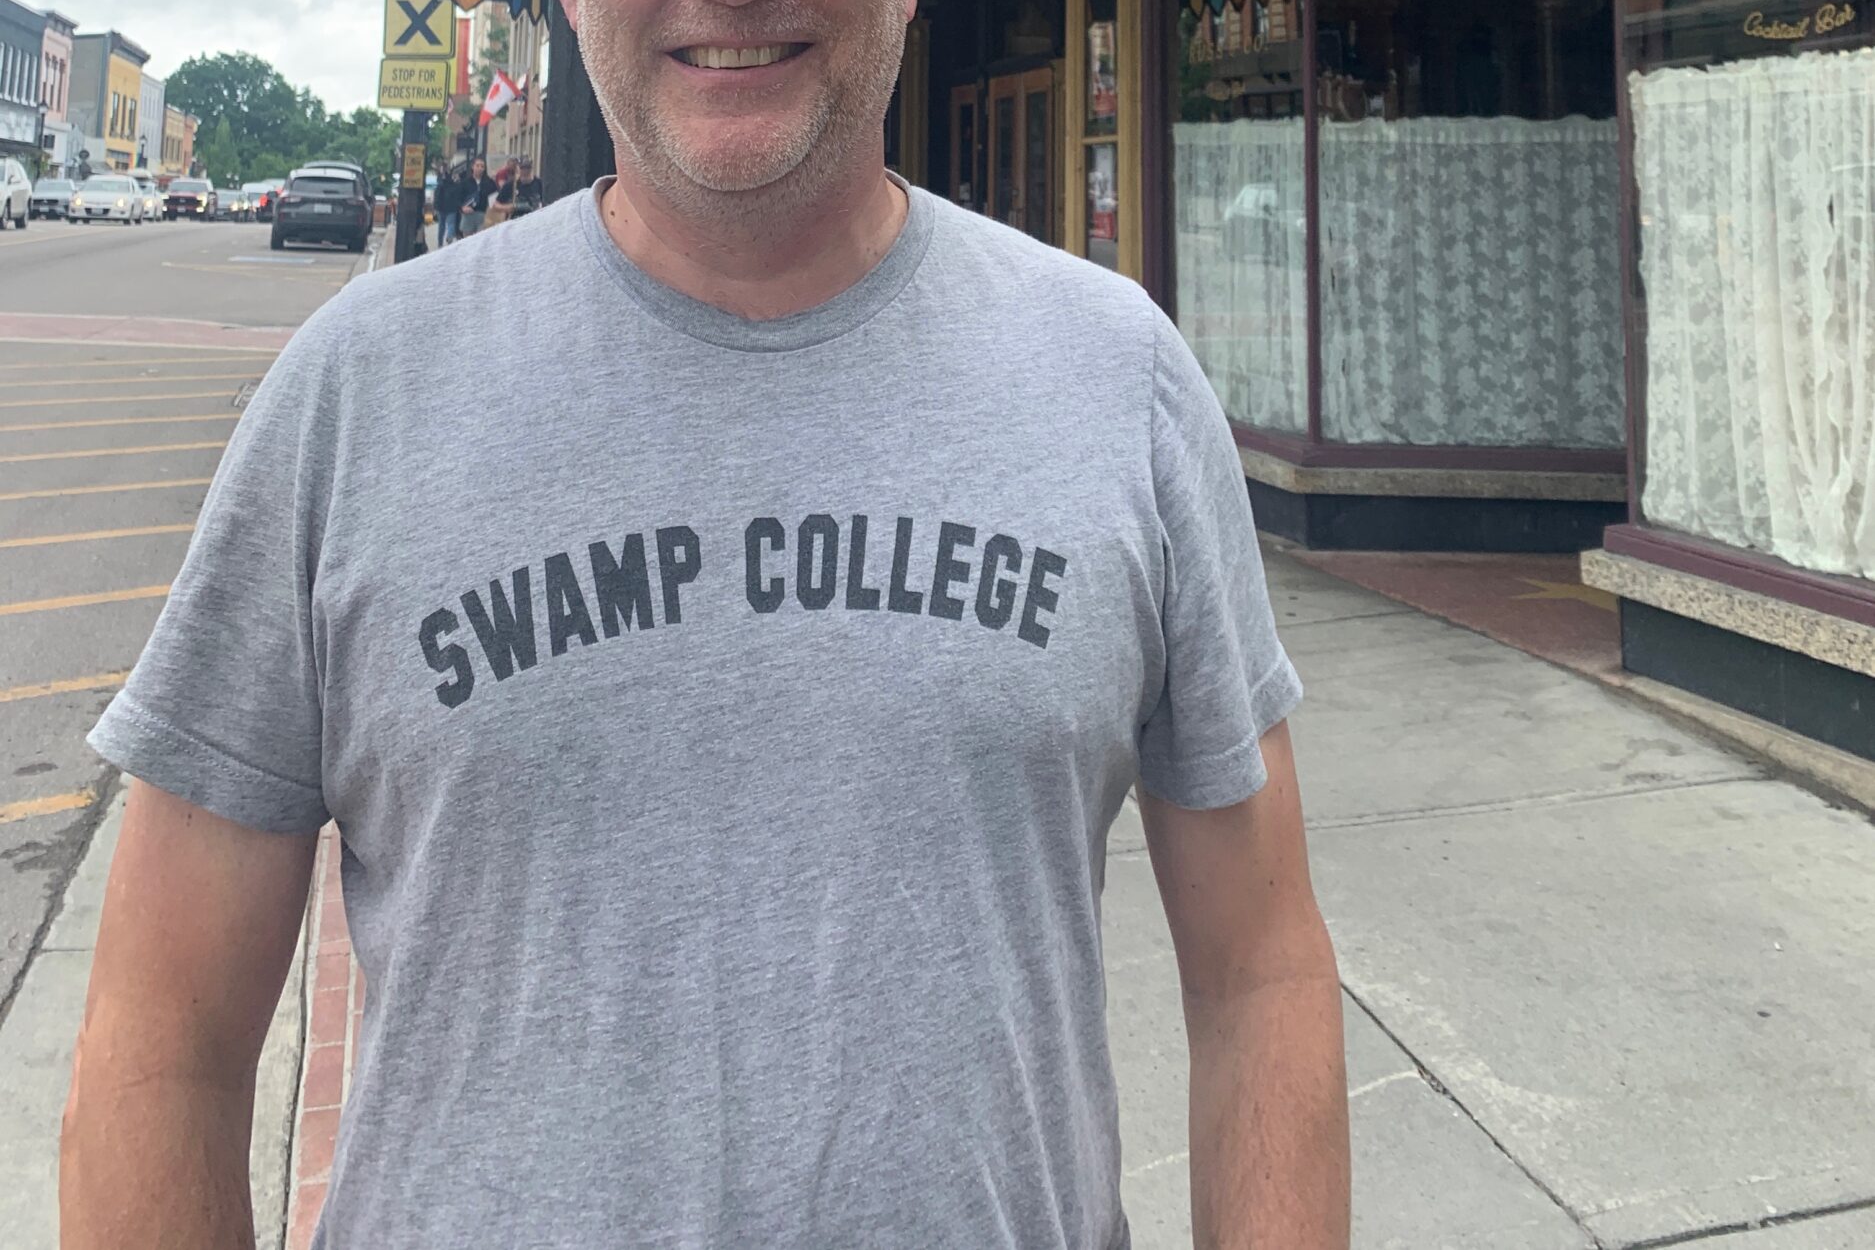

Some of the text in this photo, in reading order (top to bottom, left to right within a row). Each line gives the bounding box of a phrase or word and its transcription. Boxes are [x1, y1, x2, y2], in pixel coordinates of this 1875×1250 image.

[1743, 3, 1856, 40] Cocktail Bar
[392, 68, 436, 83] STOP FOR
[382, 85, 443, 101] PEDESTRIANS
[418, 513, 1068, 710] SWAMP COLLEGE
